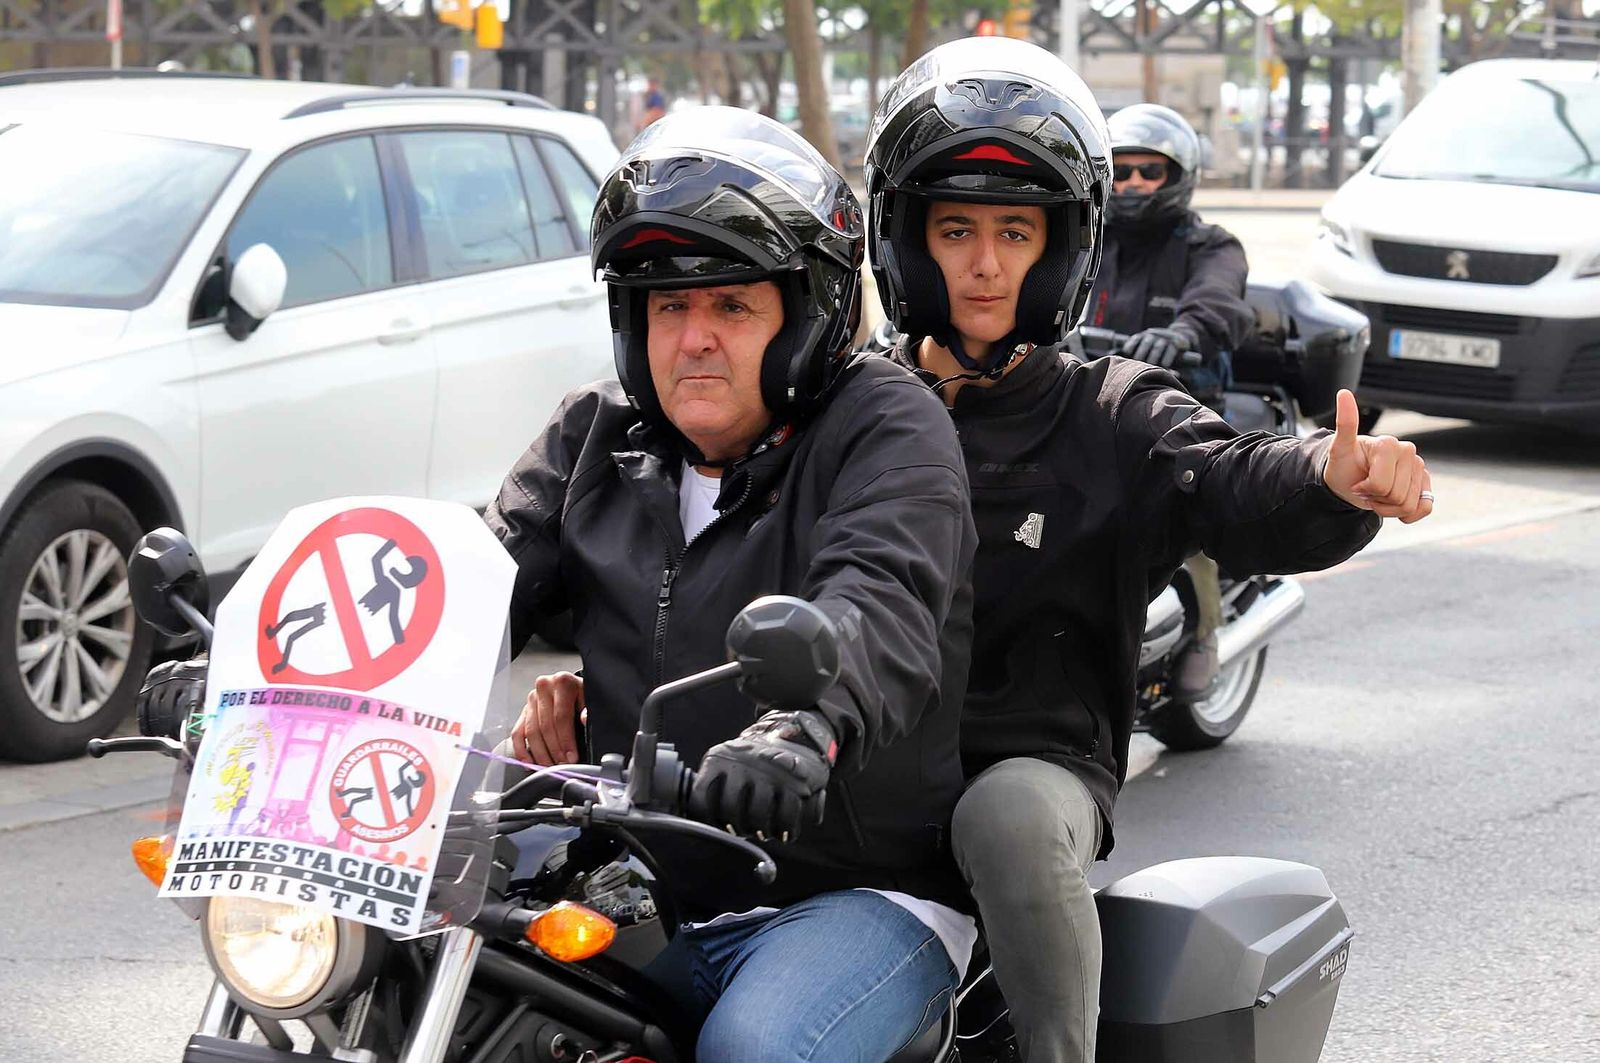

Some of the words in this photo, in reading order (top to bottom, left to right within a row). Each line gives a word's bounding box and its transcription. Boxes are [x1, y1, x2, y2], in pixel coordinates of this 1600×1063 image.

[220, 691, 245, 707] POR
[249, 690, 267, 705] EL
[271, 691, 352, 711] DERECHO
[357, 699, 370, 714] A
[377, 704, 404, 722] LA
[413, 711, 462, 736] VIDA
[177, 841, 423, 895] MANIFESTACIÓN
[188, 862, 377, 897] NACIONAL
[168, 873, 411, 927] MOTORISTAS
[1319, 949, 1347, 981] SHAD
